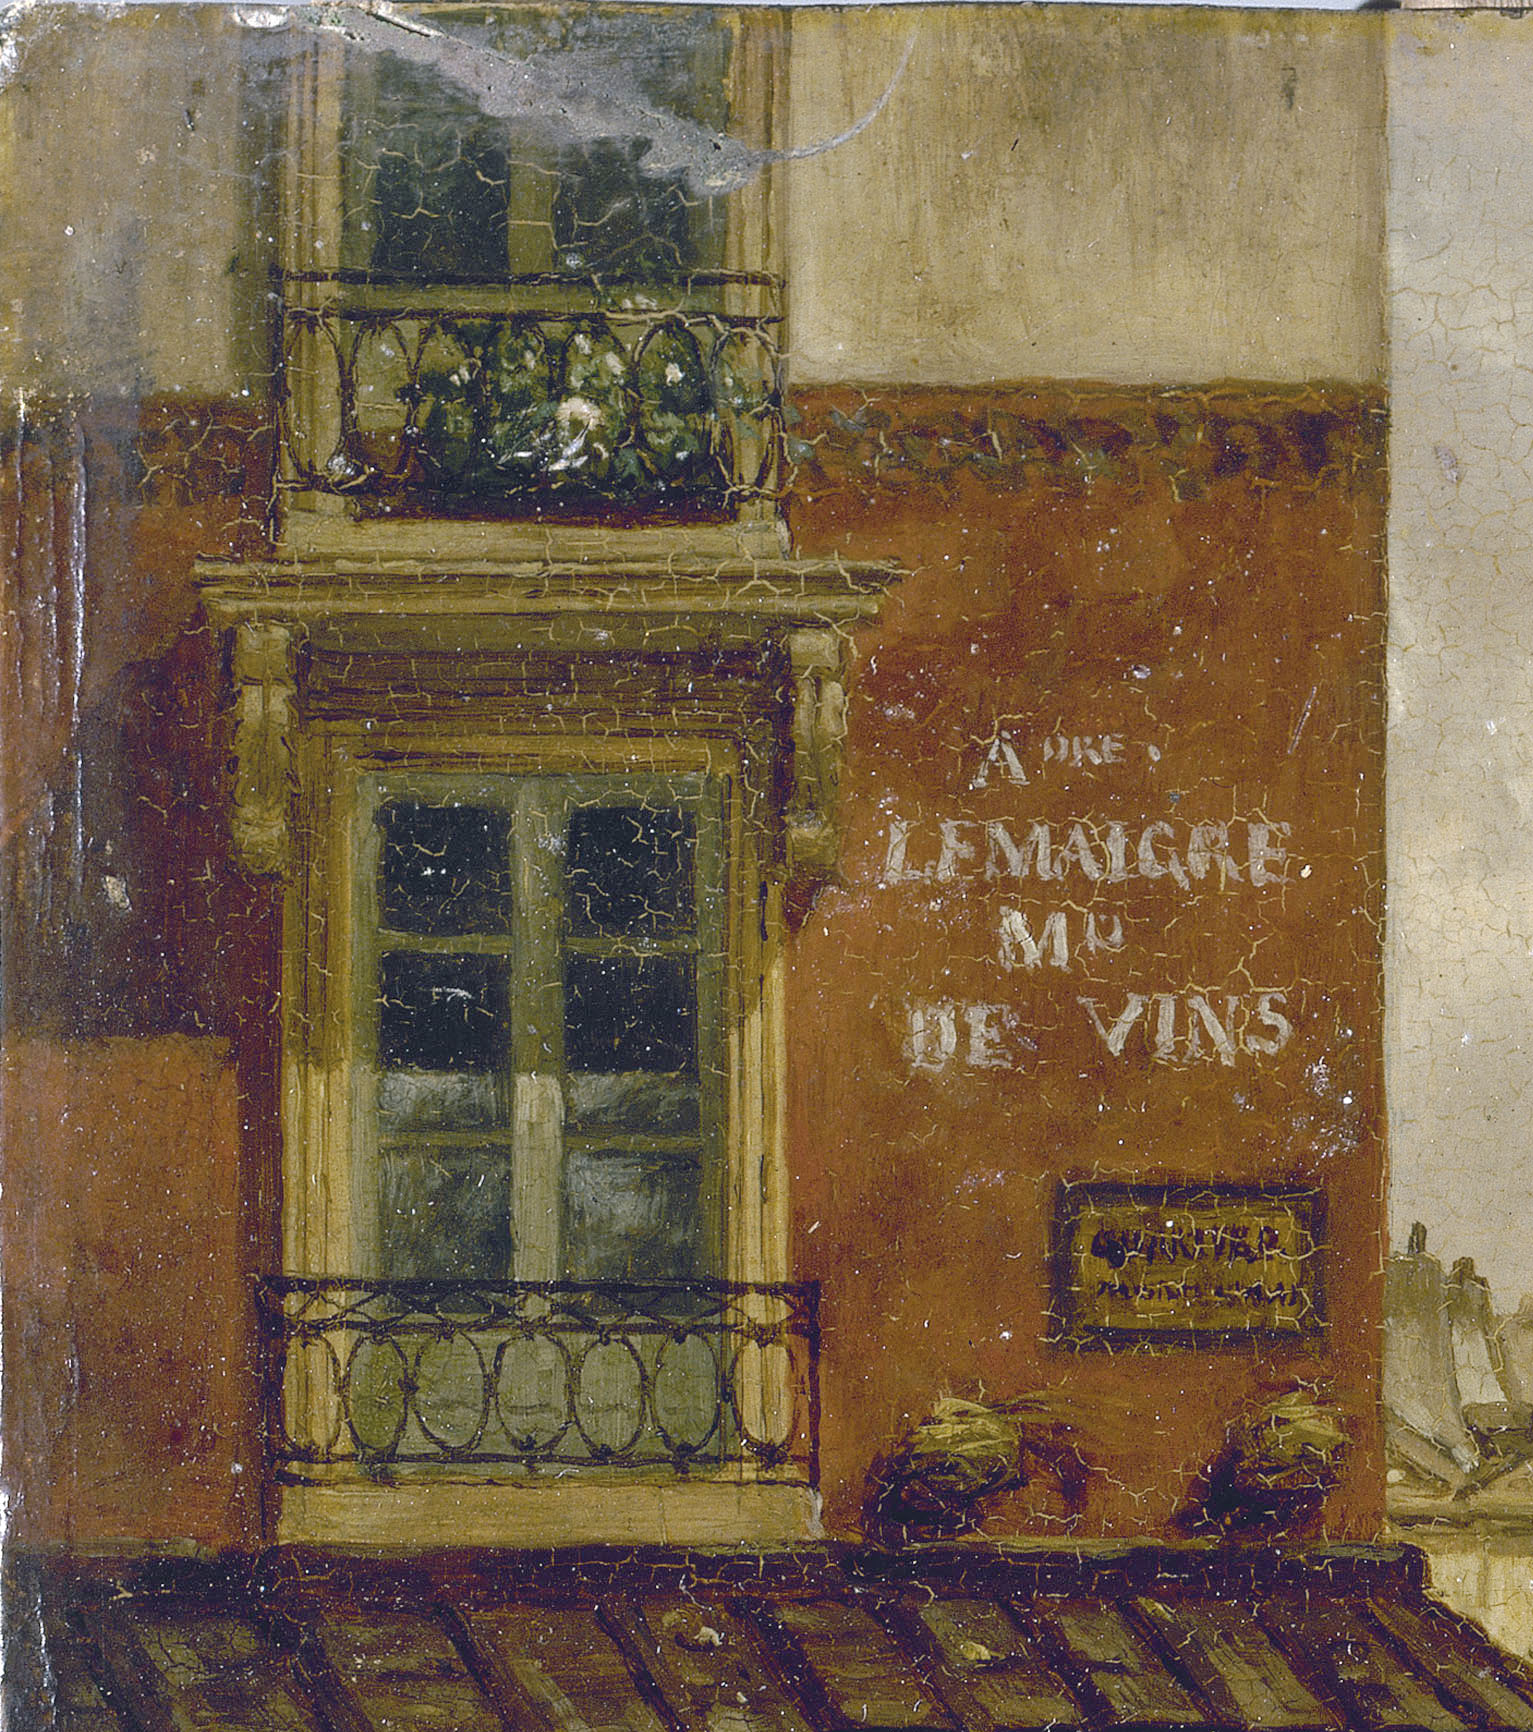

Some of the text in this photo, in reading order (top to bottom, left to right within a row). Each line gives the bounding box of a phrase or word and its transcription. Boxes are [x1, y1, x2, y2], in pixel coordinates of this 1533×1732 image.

[885, 819, 1291, 890] LEMAIGRE
[908, 993, 1294, 1070] DE VINS
